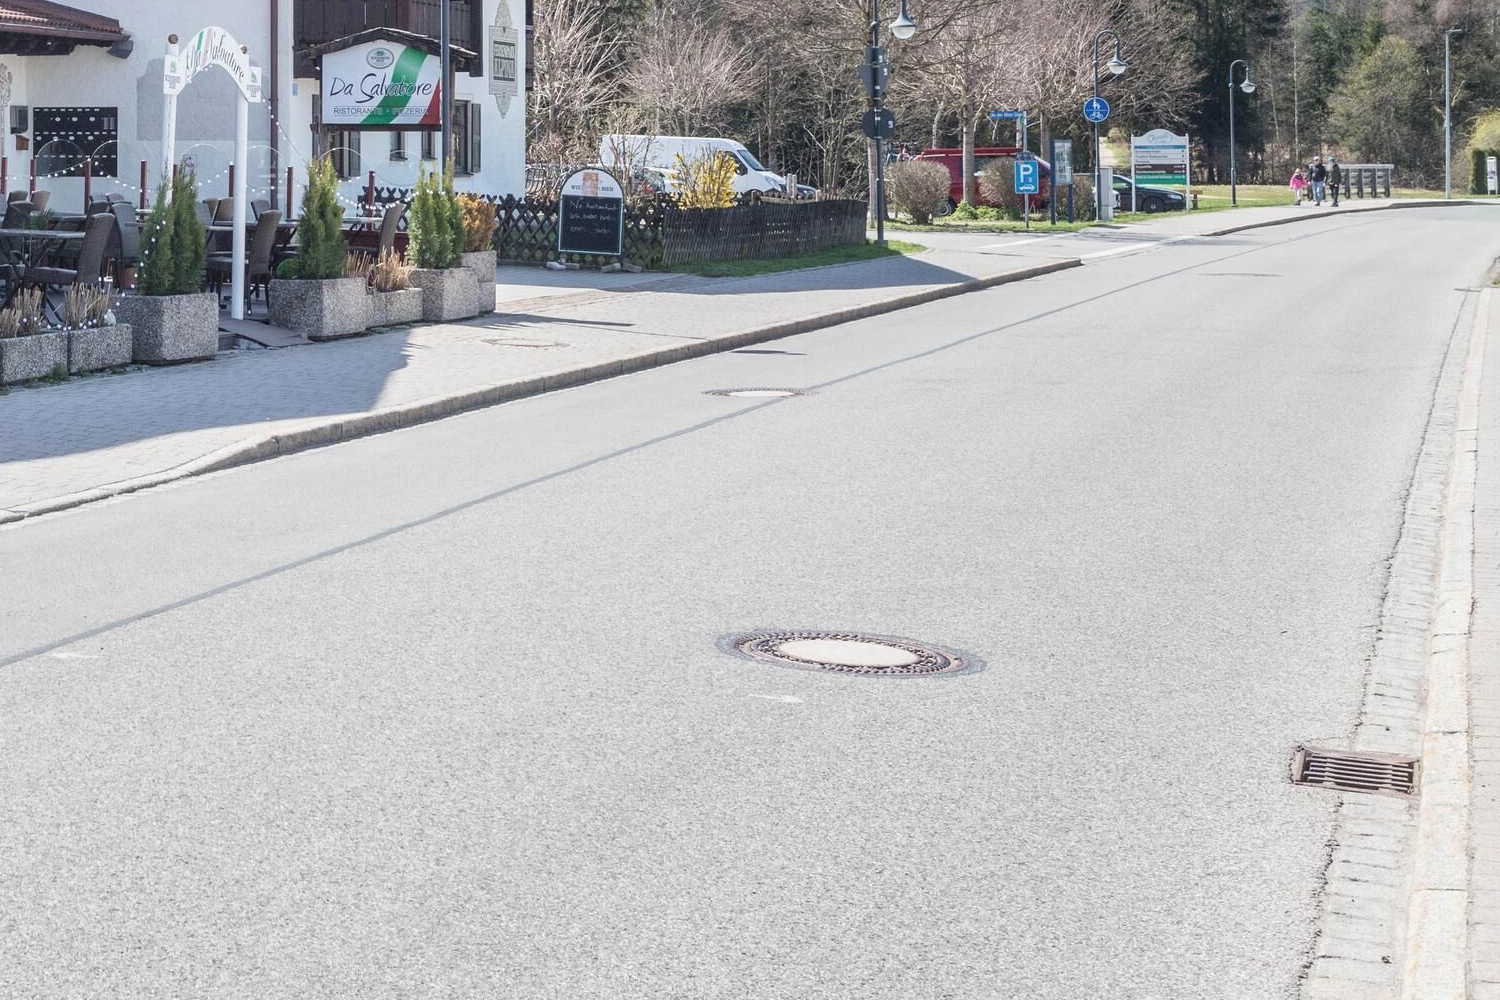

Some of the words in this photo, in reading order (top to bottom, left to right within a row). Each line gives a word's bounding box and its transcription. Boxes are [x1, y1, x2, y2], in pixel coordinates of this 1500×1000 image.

[330, 77, 354, 96] Da
[355, 73, 434, 103] Salvatore
[1020, 164, 1034, 183] P
